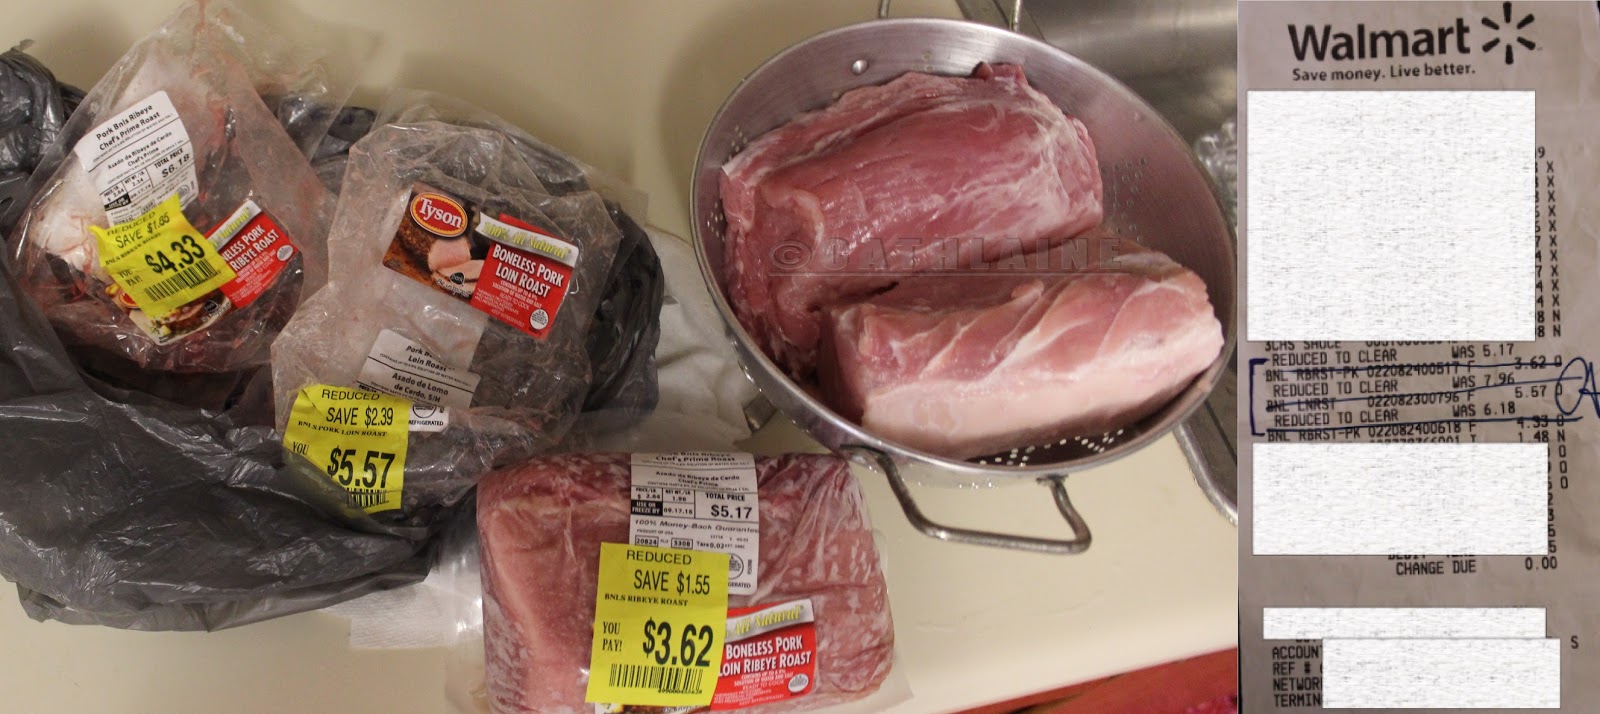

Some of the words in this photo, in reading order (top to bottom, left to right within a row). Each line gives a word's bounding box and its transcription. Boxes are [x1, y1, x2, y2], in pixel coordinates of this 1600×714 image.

[1287, 17, 1471, 62] Walmart
[1292, 67, 1327, 82] Save
[1331, 68, 1386, 82] money.
[1390, 64, 1421, 78] Live
[1424, 62, 1476, 77] better.
[96, 127, 113, 141] Pork
[113, 118, 129, 130] Bnls
[129, 104, 153, 121] Ribeye
[99, 136, 120, 151] Chef's
[120, 123, 140, 138] Prime
[140, 111, 161, 125] Roast
[154, 156, 169, 169] TOTAL
[169, 147, 184, 160] PRICE
[161, 153, 190, 179] $6.18
[1547, 161, 1554, 173] X
[1547, 175, 1555, 188] X
[1548, 190, 1555, 202] X
[418, 196, 463, 230] Tyson
[1548, 205, 1556, 217] X
[107, 211, 156, 237] REDUCED
[481, 221, 510, 241] 100%
[1549, 219, 1557, 232] X
[114, 228, 143, 250] SAVE
[221, 240, 246, 262] NELESS
[241, 224, 266, 246] PORK
[1549, 234, 1557, 247] X
[144, 234, 206, 276] $4.33
[229, 248, 257, 272] RIBEYE
[253, 228, 279, 253] ROAST
[1550, 249, 1558, 262] X
[492, 243, 537, 275] BONELESS
[536, 262, 565, 288] PORK
[1551, 264, 1559, 277] X
[125, 274, 143, 287] PAY!
[495, 262, 519, 284] LOIN
[519, 272, 551, 298] ROAST
[1551, 279, 1559, 291] X
[1552, 294, 1560, 307] X
[1552, 309, 1560, 322] N
[1553, 324, 1561, 337] N
[406, 345, 423, 355] Pork
[1272, 351, 1328, 367] REDUCED
[1335, 351, 1350, 364] TO
[1358, 349, 1398, 363] CLEAR
[1451, 345, 1475, 359] WAS
[1483, 343, 1514, 357] 5.17
[408, 355, 425, 365] Loin
[425, 360, 447, 372] Roast
[1265, 369, 1288, 382] BNL
[1467, 361, 1475, 373] F
[1514, 356, 1546, 370] 3.62
[391, 372, 415, 385] Asado
[416, 379, 426, 388] de
[427, 383, 449, 396] Lomo
[394, 383, 403, 391] de
[427, 393, 441, 403] S/H
[1273, 382, 1329, 397] REDUCED
[1336, 382, 1352, 395] TO
[1359, 379, 1399, 393] CLEAR
[1452, 376, 1476, 389] WAS
[1484, 372, 1515, 387] 7.96
[321, 388, 380, 402] REDUCED
[1266, 400, 1289, 412] BNL
[1298, 397, 1337, 411] LNRST
[1467, 389, 1475, 401] F
[1515, 385, 1547, 399] 5.57
[326, 407, 358, 426] SAVE
[364, 406, 394, 428] $2.39
[1275, 413, 1330, 427] REDUCED
[1337, 411, 1353, 424] TO
[1360, 410, 1399, 423] CLEAR
[1452, 405, 1476, 417] WAS
[1484, 401, 1516, 415] 6.18
[297, 420, 317, 430] BNLS
[317, 424, 340, 434] PORK
[341, 428, 360, 437] LOIN
[1268, 429, 1290, 442] BNL
[1299, 427, 1361, 442] RBRST-PK
[1469, 421, 1477, 433] F
[1517, 415, 1549, 429] 4.33
[1518, 430, 1549, 443] 1.48
[1557, 429, 1566, 442] N
[291, 441, 310, 456] YOU
[327, 444, 396, 489] $5.57
[705, 492, 725, 500] TOTAL
[727, 493, 746, 502] PRICE
[710, 503, 753, 519] $5.17
[635, 519, 657, 527] 100%
[659, 521, 713, 531] Money-Back
[626, 549, 692, 566] REDUCED
[1396, 562, 1445, 576] CHANGE
[1452, 560, 1477, 574] DUE
[1524, 556, 1558, 570] 0.00
[633, 569, 670, 592] SAVE
[676, 570, 710, 596] $1.55
[604, 593, 626, 601] BNLS
[627, 594, 659, 604] RIBEYE
[661, 596, 689, 606] ROAST
[602, 621, 621, 635] YOU
[735, 616, 751, 635] All
[602, 639, 623, 653] PAY!
[642, 617, 714, 668] $3.62
[725, 639, 774, 660] BONELESS
[775, 635, 803, 653] PORK
[743, 655, 777, 673] RIBEYE
[779, 650, 812, 668] ROAST
[1272, 645, 1322, 660] ACCOUN
[1272, 661, 1295, 676] REF
[1303, 661, 1311, 674] #
[1272, 677, 1322, 691] NETWOR
